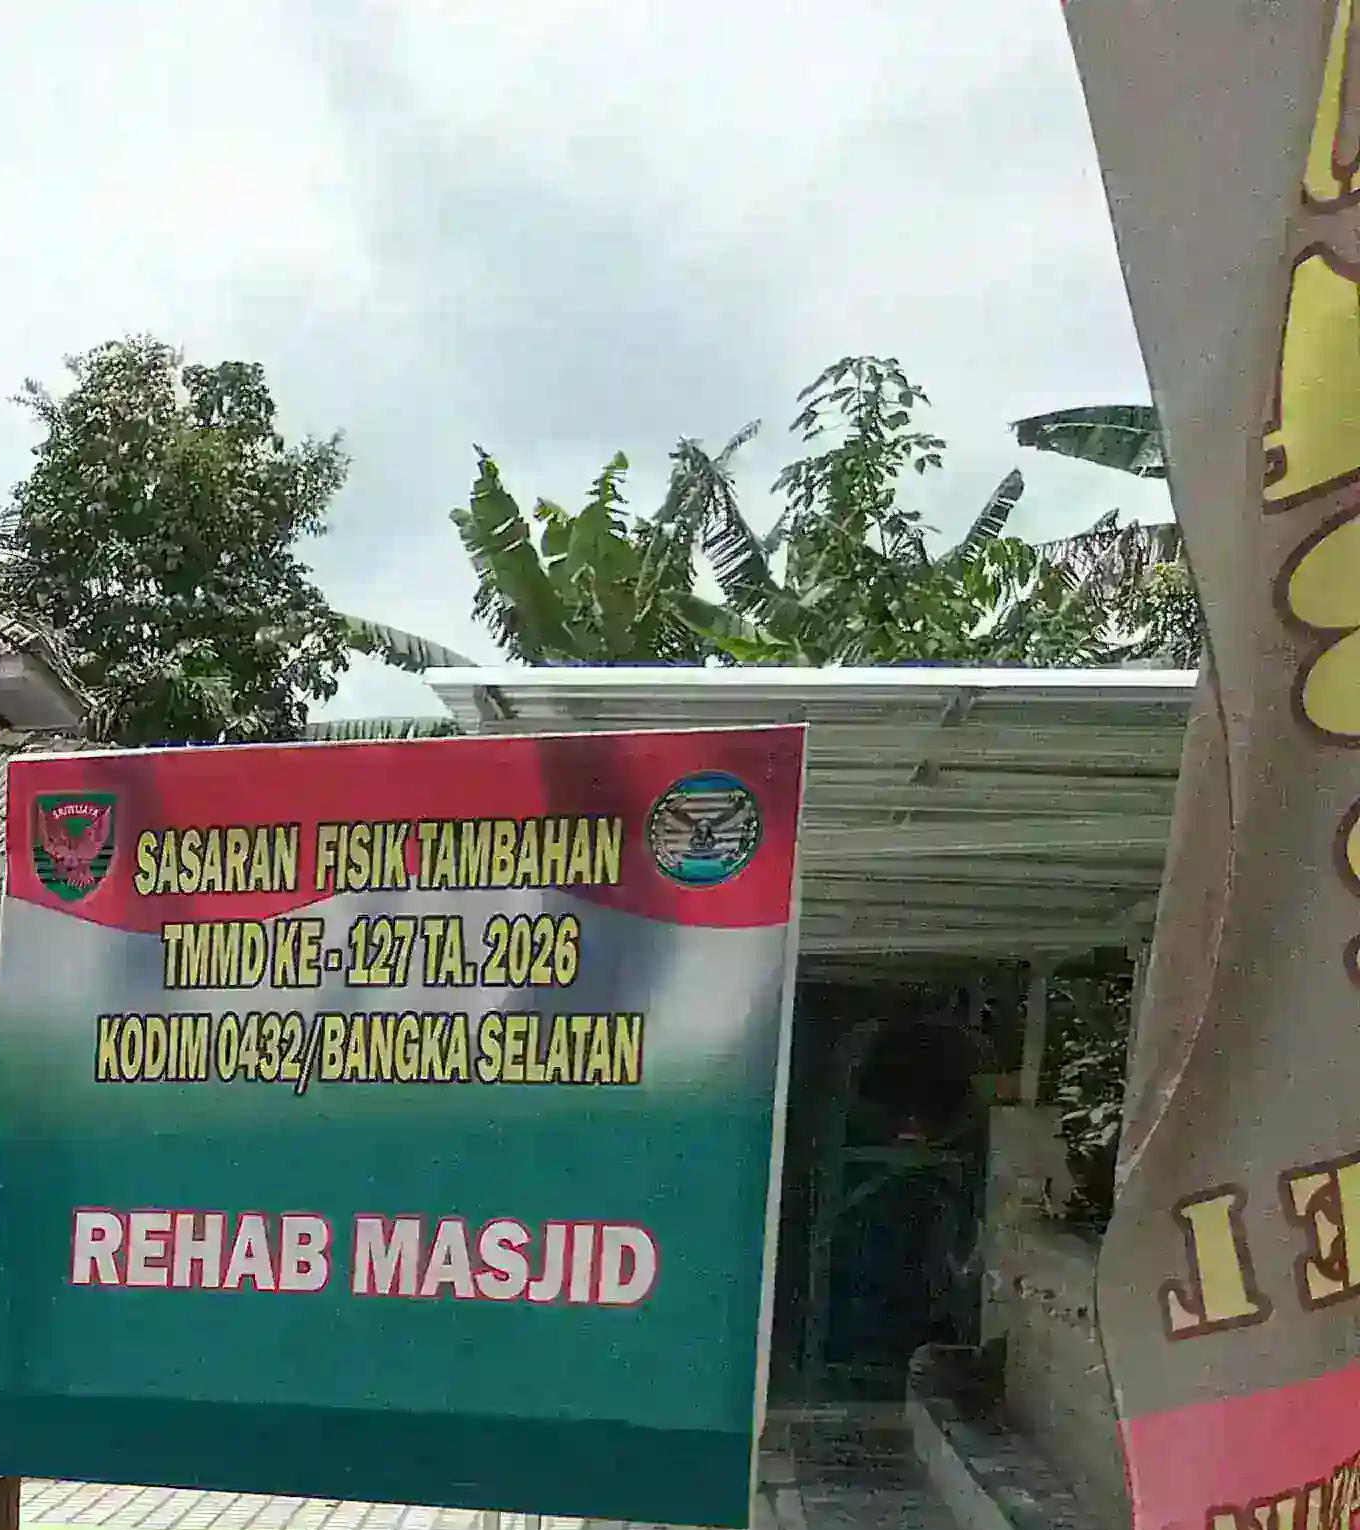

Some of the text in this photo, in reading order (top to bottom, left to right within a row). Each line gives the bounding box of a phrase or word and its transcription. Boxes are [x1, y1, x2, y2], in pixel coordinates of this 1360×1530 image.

[133, 816, 624, 895] SASARAN FISIK TAMBAHAN
[162, 920, 269, 989] TMMD
[270, 917, 324, 988] KE
[346, 914, 417, 987] 127
[422, 914, 478, 987] TA.
[481, 912, 580, 987] 2026
[95, 1010, 643, 1095] KODIM 0432/BANGKA SELATAN
[70, 1209, 658, 1306] REHAB MASJID
